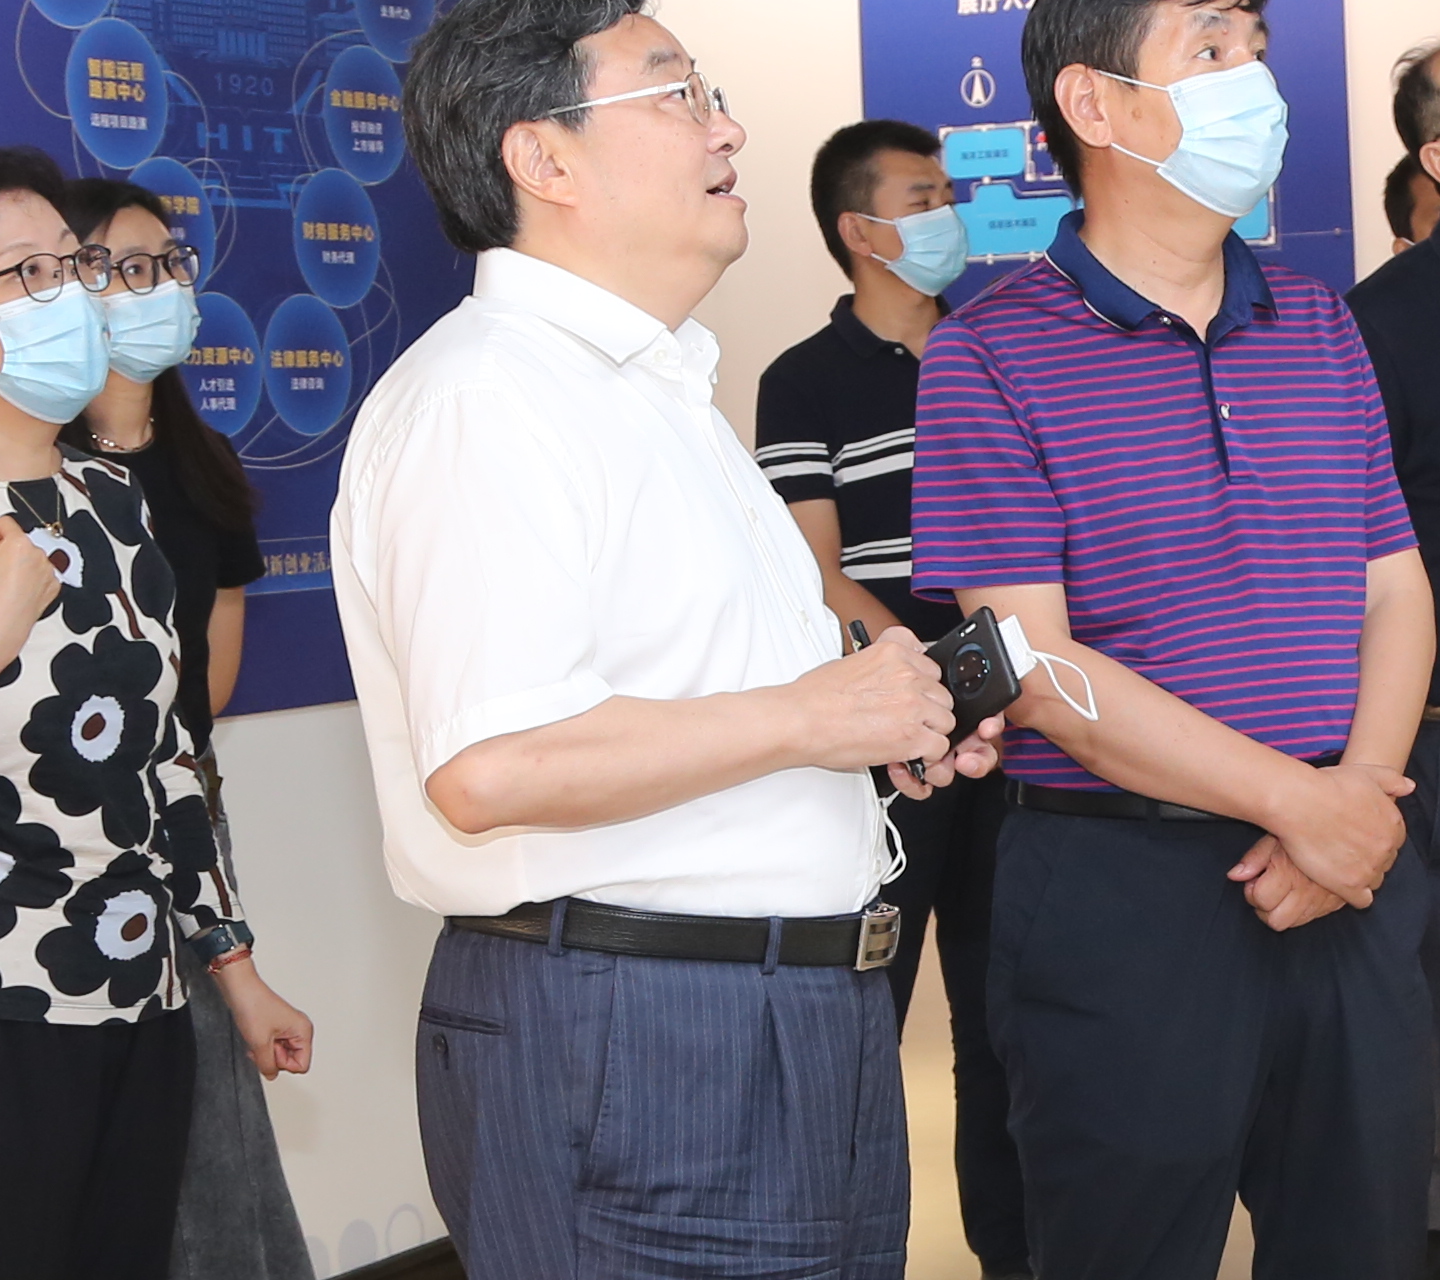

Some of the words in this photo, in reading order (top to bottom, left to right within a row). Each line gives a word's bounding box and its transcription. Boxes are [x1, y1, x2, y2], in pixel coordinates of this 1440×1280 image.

[214, 72, 274, 96] 1920
[196, 122, 292, 153] HIT
[303, 222, 375, 242] 财务服务中心
[183, 347, 254, 366] 力资源中心
[270, 349, 344, 368] 法律服务中心
[199, 377, 235, 392] 人才引进
[263, 551, 331, 577] 新创业活
